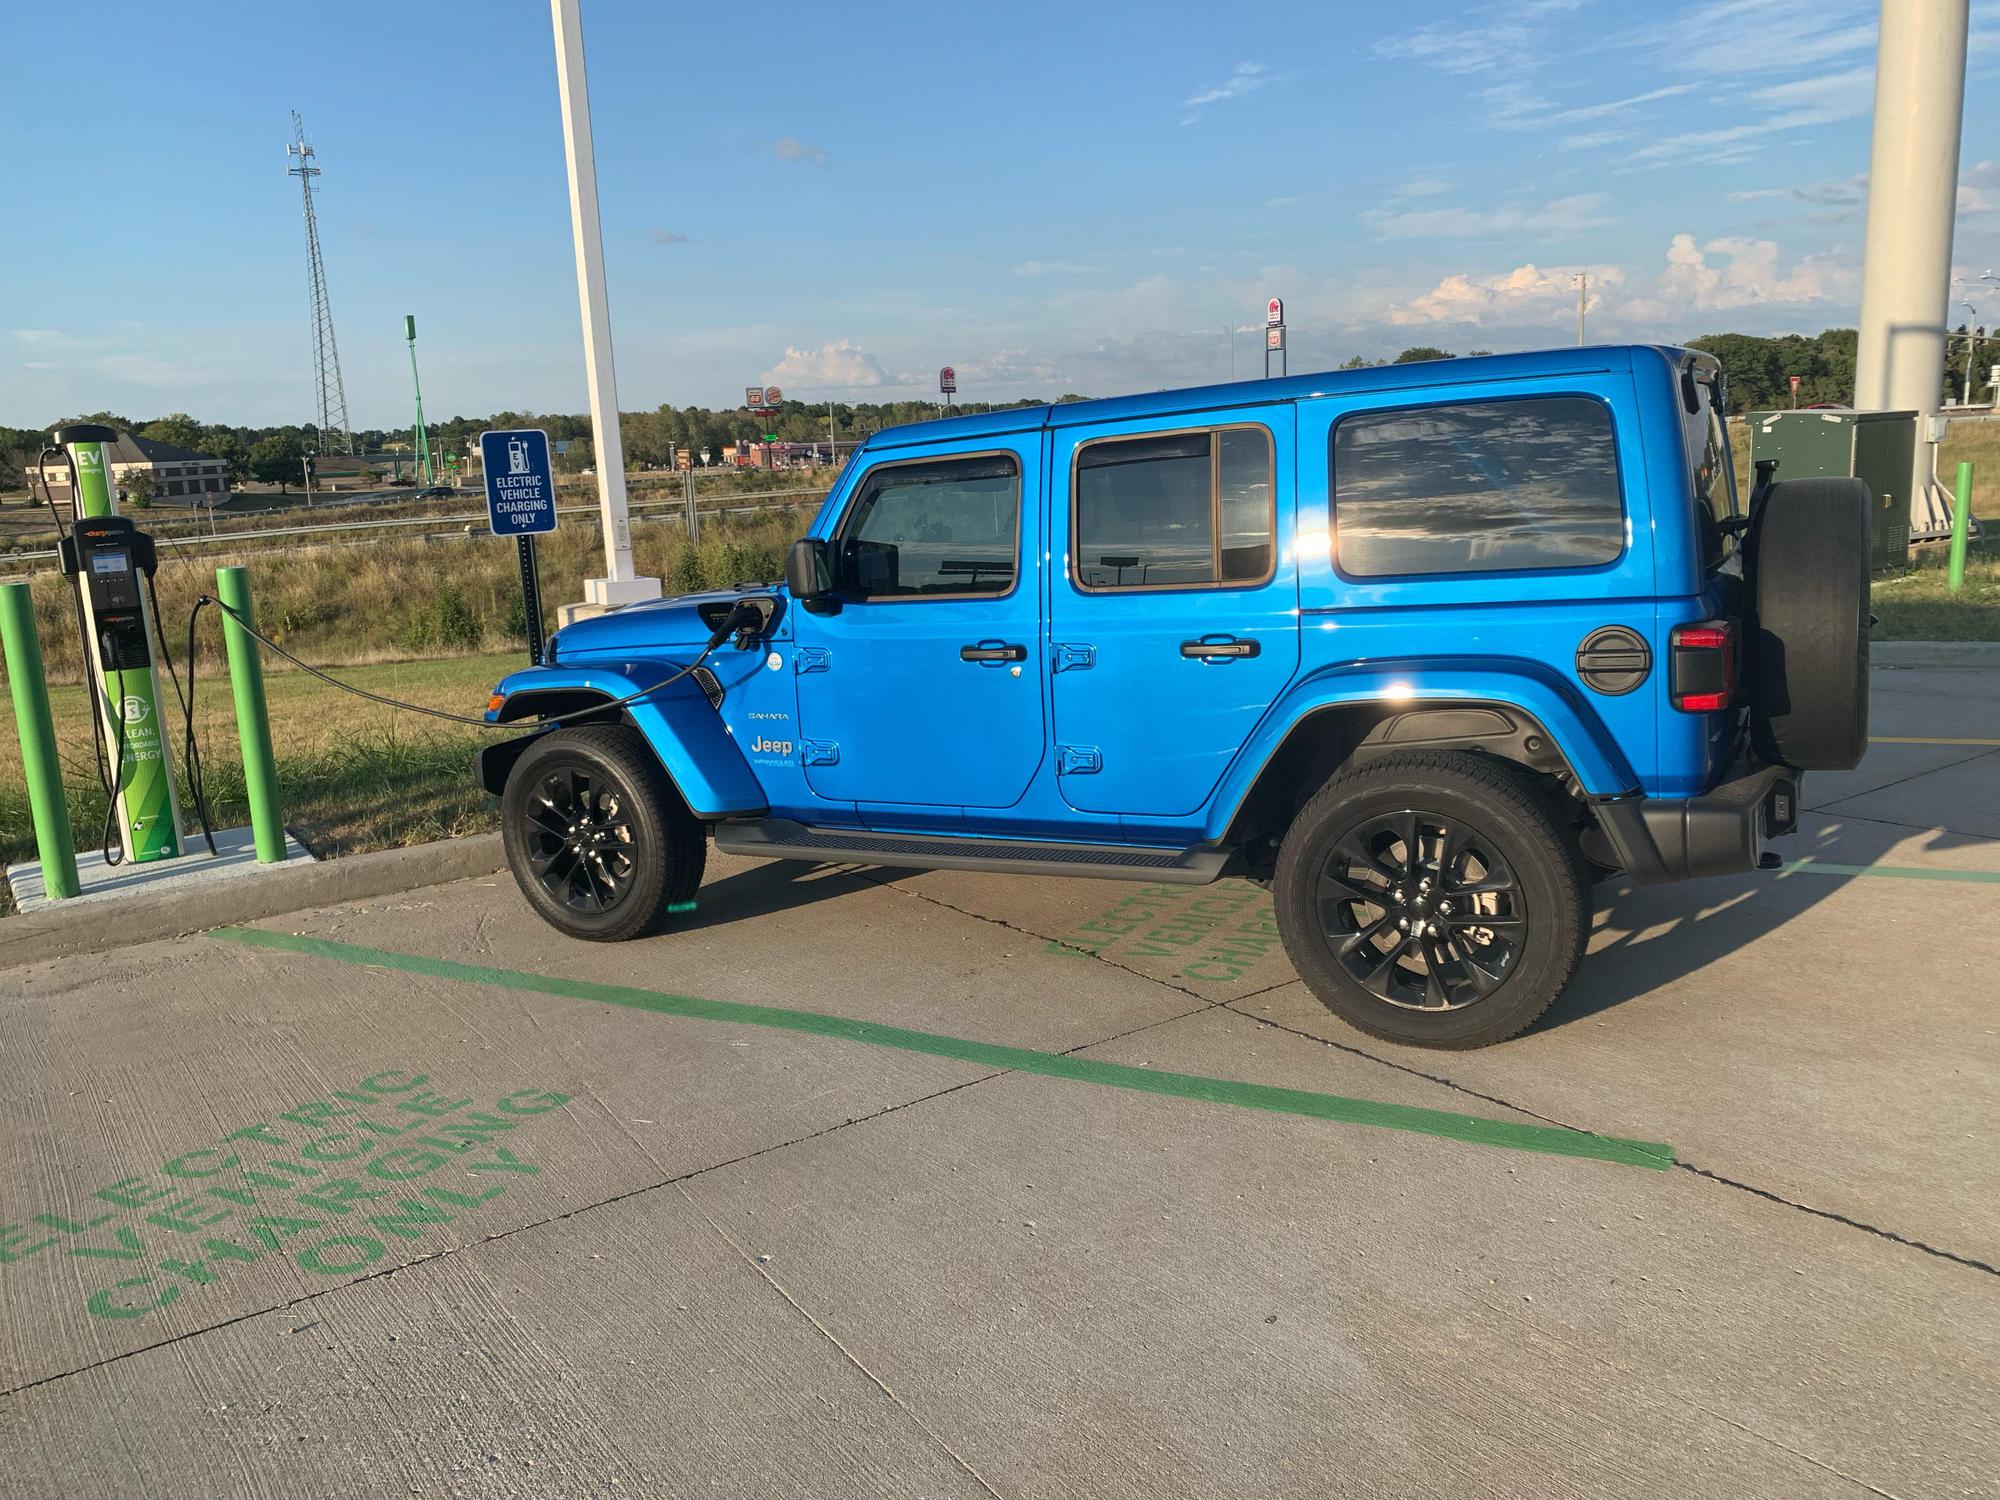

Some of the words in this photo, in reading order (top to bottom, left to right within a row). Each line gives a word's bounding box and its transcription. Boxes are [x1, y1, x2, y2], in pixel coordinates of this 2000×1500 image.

[77, 450, 100, 466] EV
[496, 475, 542, 488] ELECTRIC
[500, 488, 540, 500] VEHICLE
[496, 500, 547, 513] CHARGING
[511, 513, 536, 524] ONLY
[748, 712, 789, 720] SAHARA
[123, 728, 155, 739] LEAN,
[751, 735, 792, 757] Jeep
[0, 1070, 428, 1264] ELECTRIC
[64, 1091, 473, 1261] VEHICLE
[87, 1089, 571, 1320] CHARGING
[296, 1148, 541, 1276] ONLY
